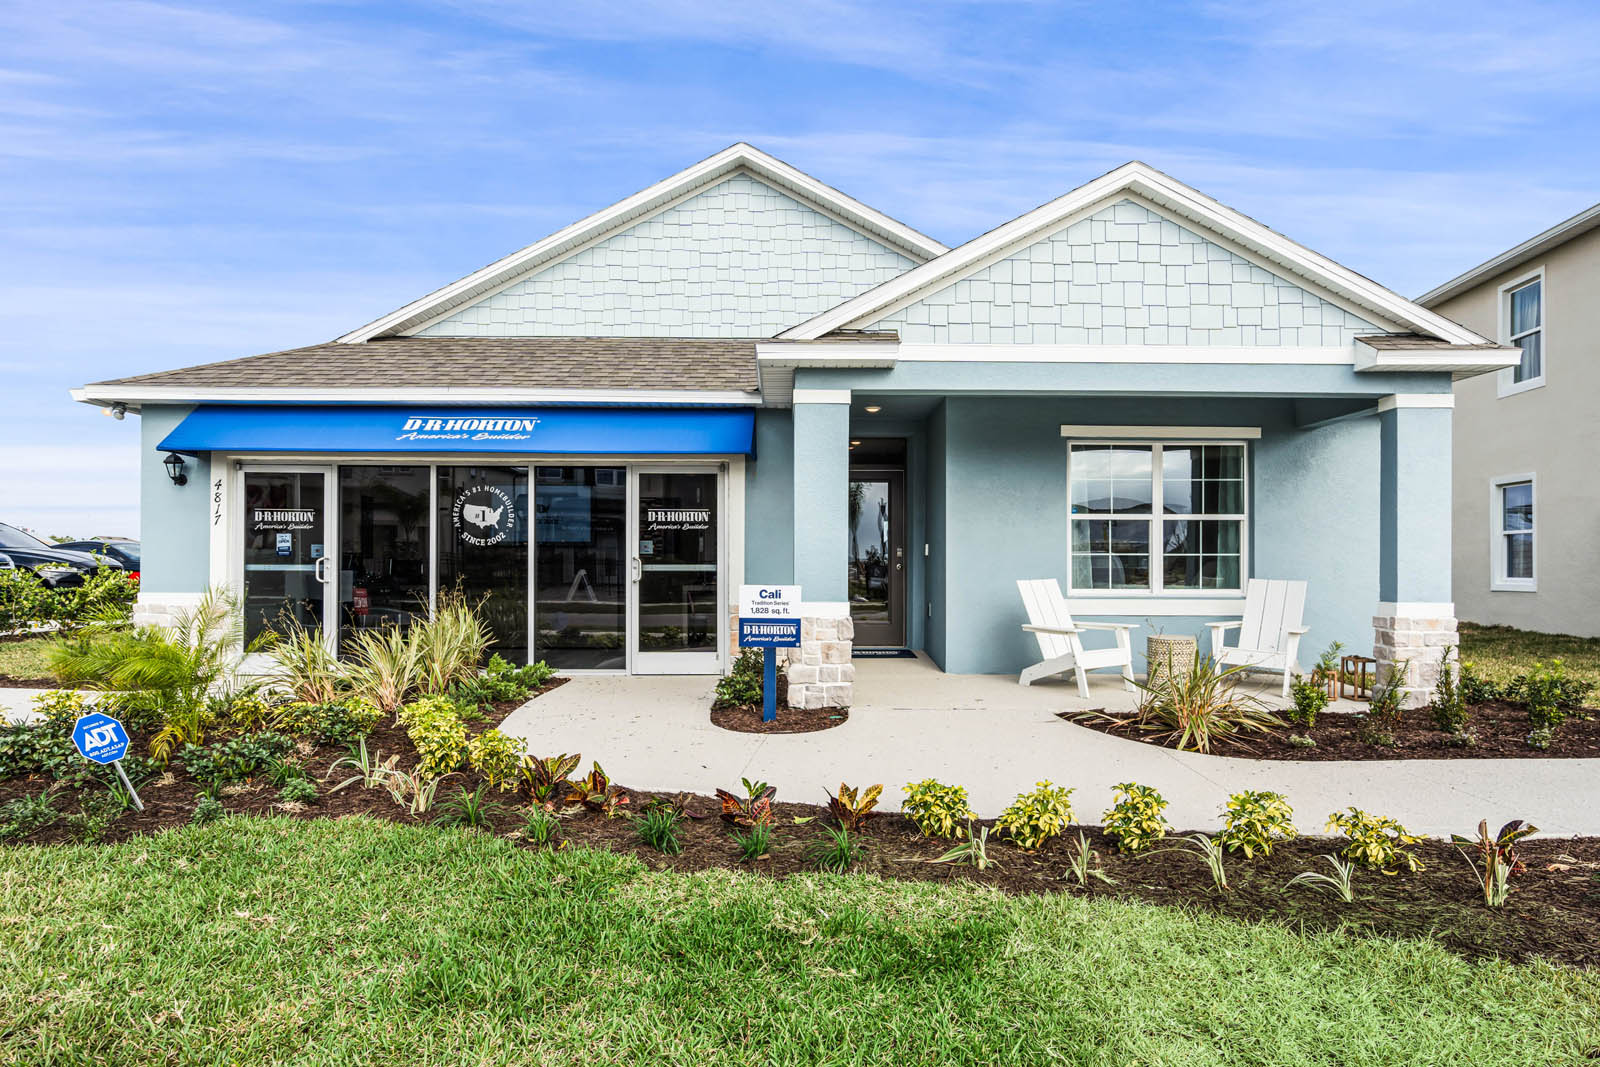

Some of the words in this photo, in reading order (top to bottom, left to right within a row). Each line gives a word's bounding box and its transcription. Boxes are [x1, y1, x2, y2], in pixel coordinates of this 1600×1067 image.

[396, 432, 469, 440] America's
[472, 432, 530, 440] Builder
[214, 479, 222, 525] 4817
[453, 490, 471, 527] AMERICA'S
[485, 485, 515, 528] HOMEBUILDER
[254, 522, 286, 530] America's
[648, 522, 680, 530] America's
[461, 532, 486, 546] SINCE
[487, 532, 506, 546] 2002
[759, 589, 782, 599] Cali
[751, 607, 769, 615] 1,828
[85, 723, 118, 752] ADT
